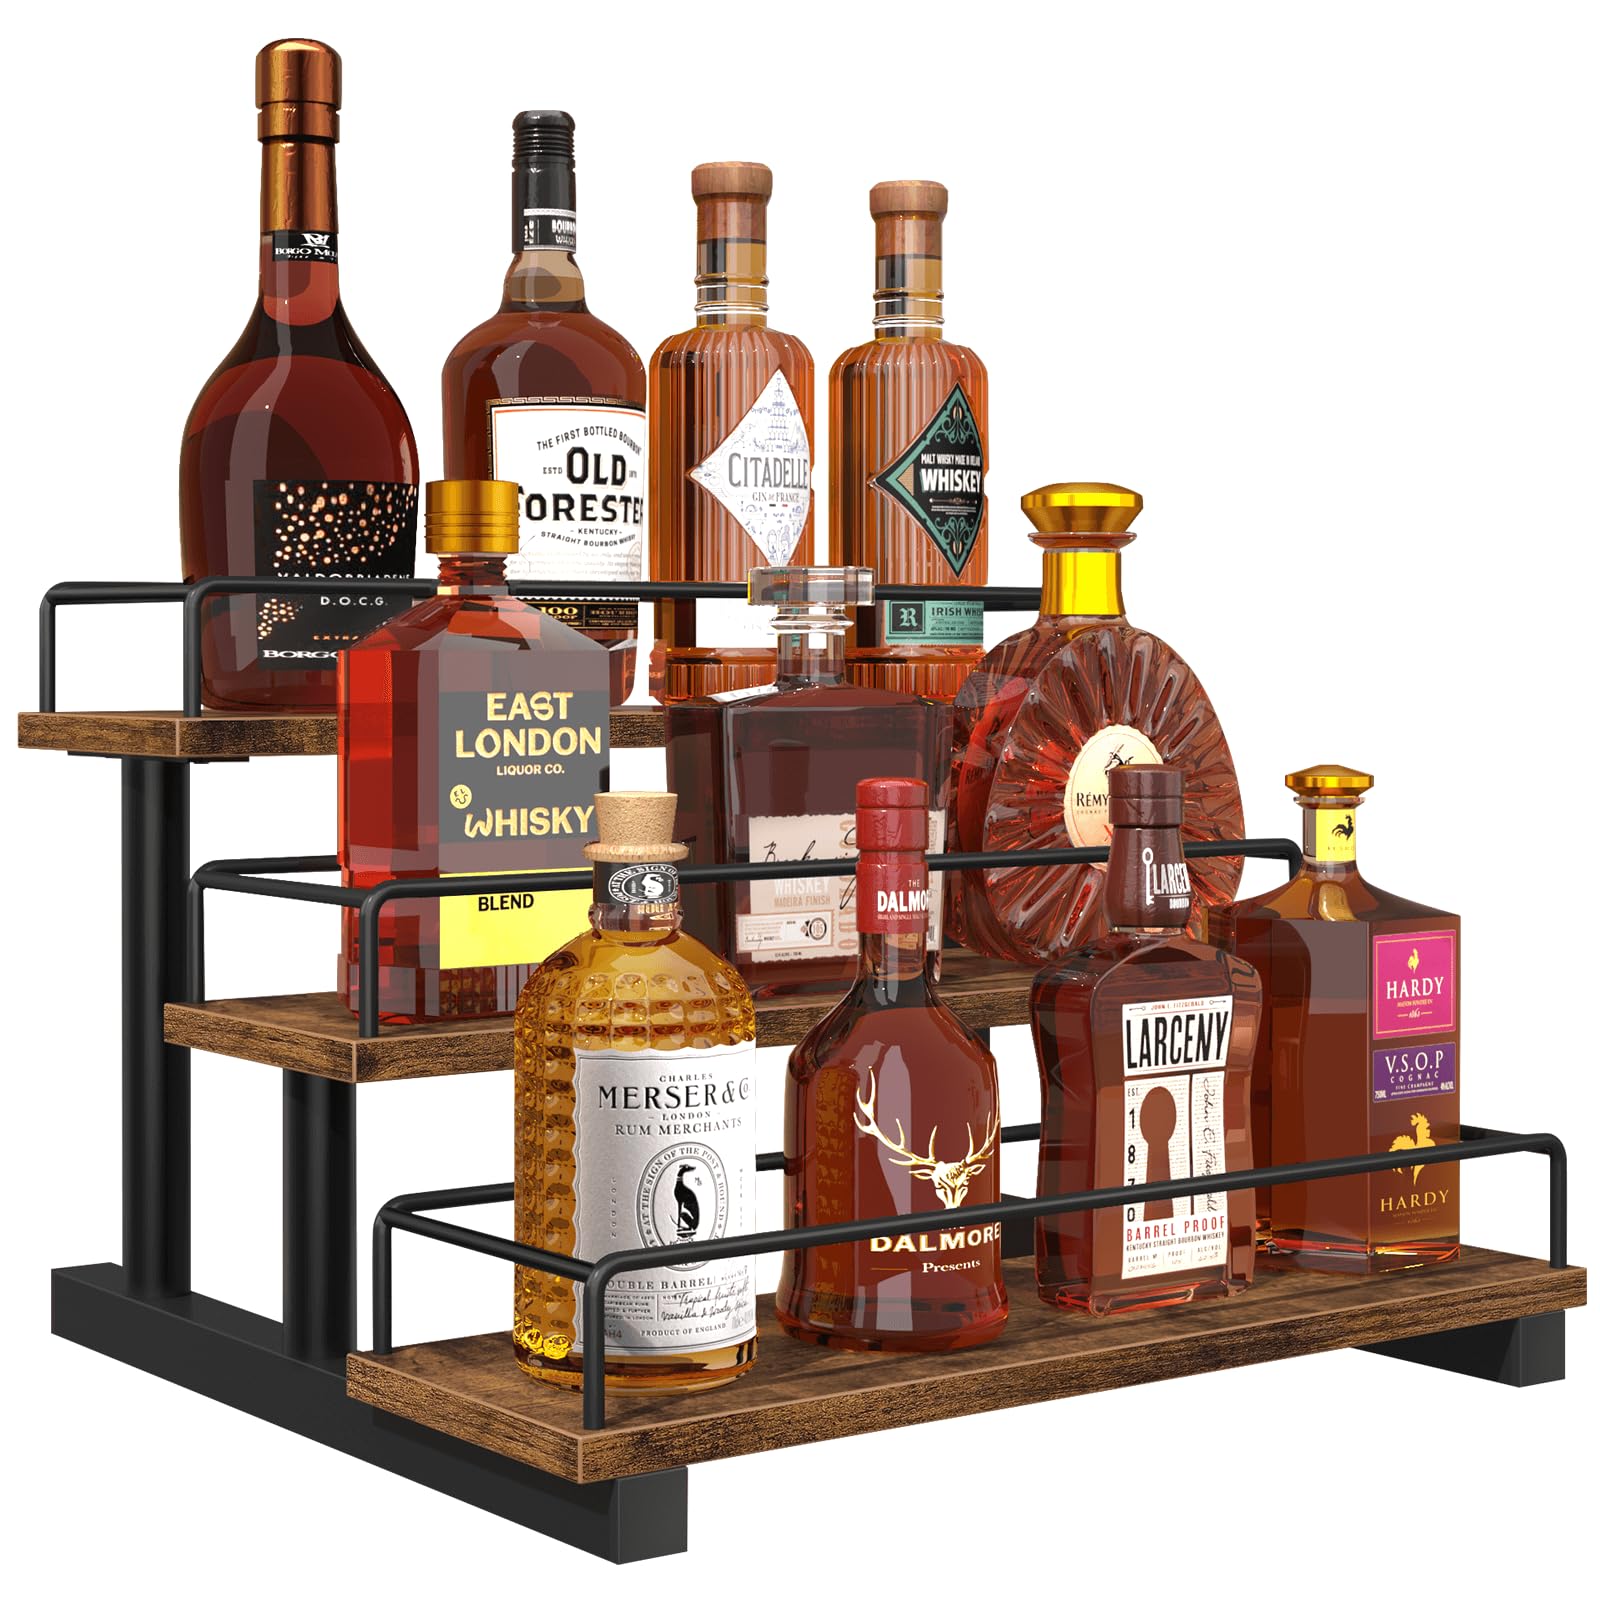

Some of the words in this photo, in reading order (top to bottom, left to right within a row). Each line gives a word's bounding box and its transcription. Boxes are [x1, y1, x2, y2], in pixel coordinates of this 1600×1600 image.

[537, 438, 554, 451] THE
[555, 428, 580, 445] FIRST
[583, 426, 618, 438] BOTTLED
[543, 467, 563, 475] ESTD
[566, 446, 626, 486] OLD
[921, 453, 936, 465] MALT
[728, 452, 808, 489] CITADELLE
[921, 468, 981, 493] WHISKEY
[517, 486, 643, 525] ORESTE
[752, 492, 767, 502] GIN
[776, 492, 799, 503] FRANCE
[541, 531, 582, 545] STRAIGHT
[583, 538, 618, 547] BOURBON
[578, 528, 618, 536] KENTUCKY
[931, 607, 962, 617] IRISH
[486, 691, 573, 722] EAST
[455, 727, 601, 759] LONDON
[496, 765, 542, 776] LIQUOR
[544, 764, 565, 775] CO.
[464, 806, 594, 839] WHISKY
[478, 894, 534, 912] BLEND
[805, 896, 831, 906] FINISH
[877, 890, 929, 912] DALMO
[1386, 976, 1444, 999] HARDY
[1126, 1011, 1229, 1069] LARCENY
[1385, 1050, 1444, 1074] V.S.O.P
[659, 1073, 713, 1083] CHARLES
[1390, 1071, 1439, 1083] COGNAC
[615, 1124, 650, 1135] RUM
[658, 1117, 742, 1135] MERCHANTS
[662, 1111, 711, 1121] LONDON
[663, 1149, 677, 1161] OF
[679, 1147, 700, 1155] THE
[701, 1150, 719, 1170] POST
[647, 1160, 664, 1186] SIGN
[641, 1187, 651, 1210] THE
[1381, 1189, 1449, 1212] HARDY
[641, 1214, 651, 1226] AT
[1127, 1223, 1175, 1242] BARREL
[1184, 1216, 1225, 1234] PROOF
[870, 1221, 1001, 1252] DALMORE
[1126, 1242, 1152, 1252] KENTUCKY
[1153, 1238, 1177, 1248] STRAIGHT
[1178, 1235, 1201, 1245] BOURBON
[1202, 1231, 1225, 1241] WHISKEY
[922, 1260, 981, 1273] Presents
[606, 1280, 655, 1290] OUBLE
[660, 1278, 713, 1290] BARREL
[640, 1329, 680, 1337] PRODUCT
[682, 1327, 692, 1335] OF
[695, 1323, 727, 1334] ENGLAND
